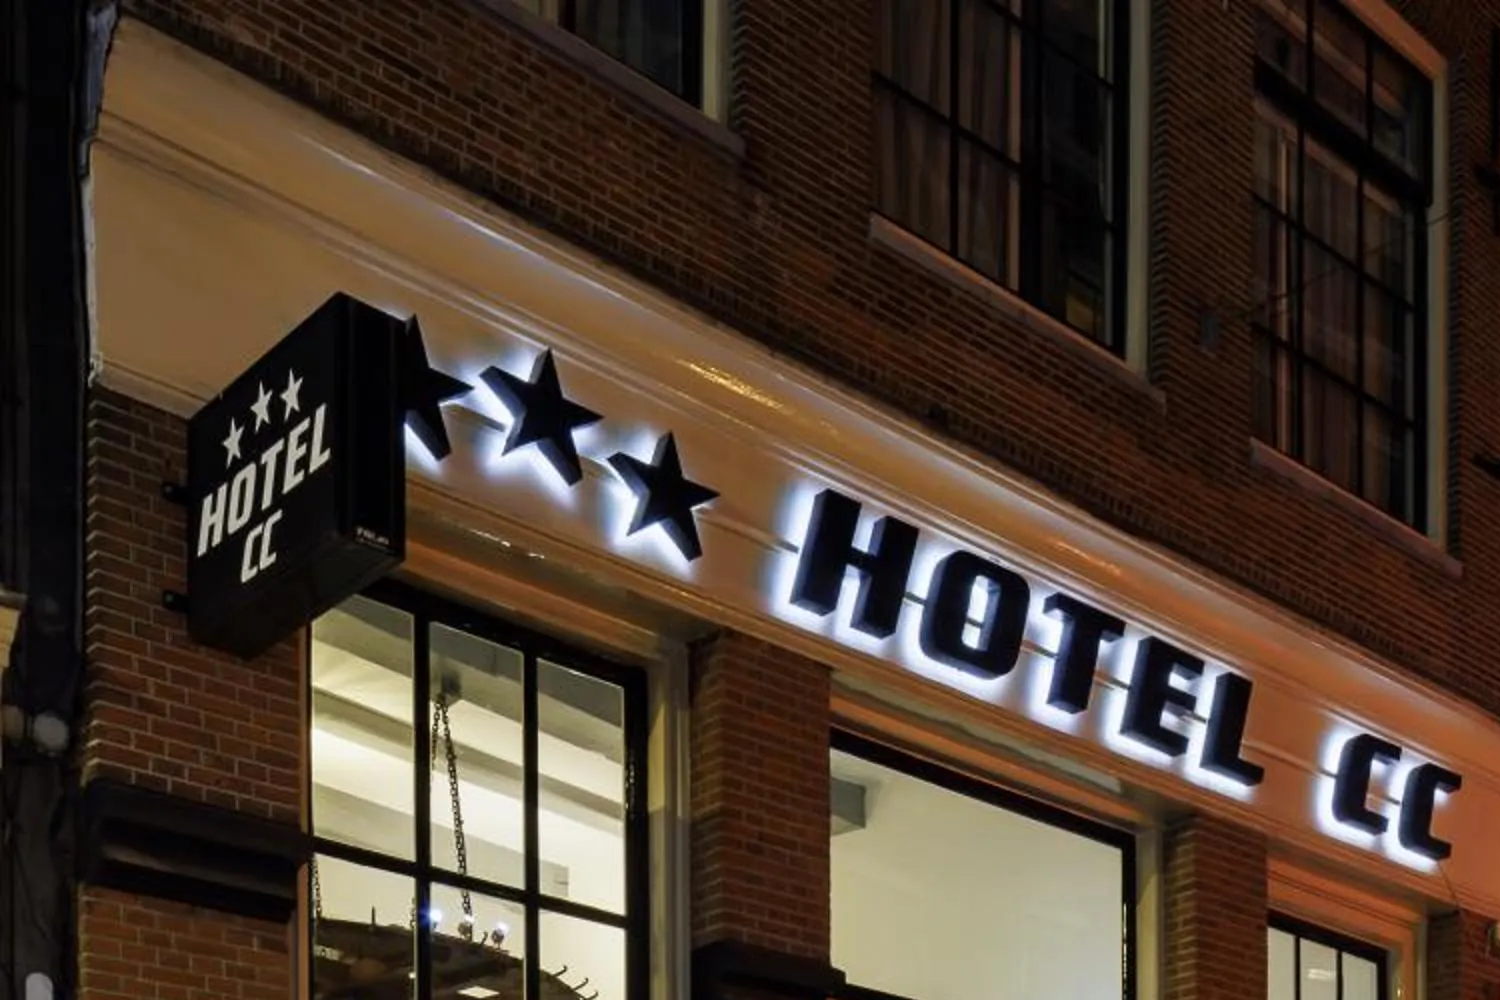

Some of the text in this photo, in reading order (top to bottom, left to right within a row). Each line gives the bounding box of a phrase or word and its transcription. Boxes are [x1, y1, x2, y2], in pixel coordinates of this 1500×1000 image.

[198, 402, 331, 557] HOTEL
[240, 509, 283, 584] CC
[789, 487, 1462, 861] HOTEL CC
